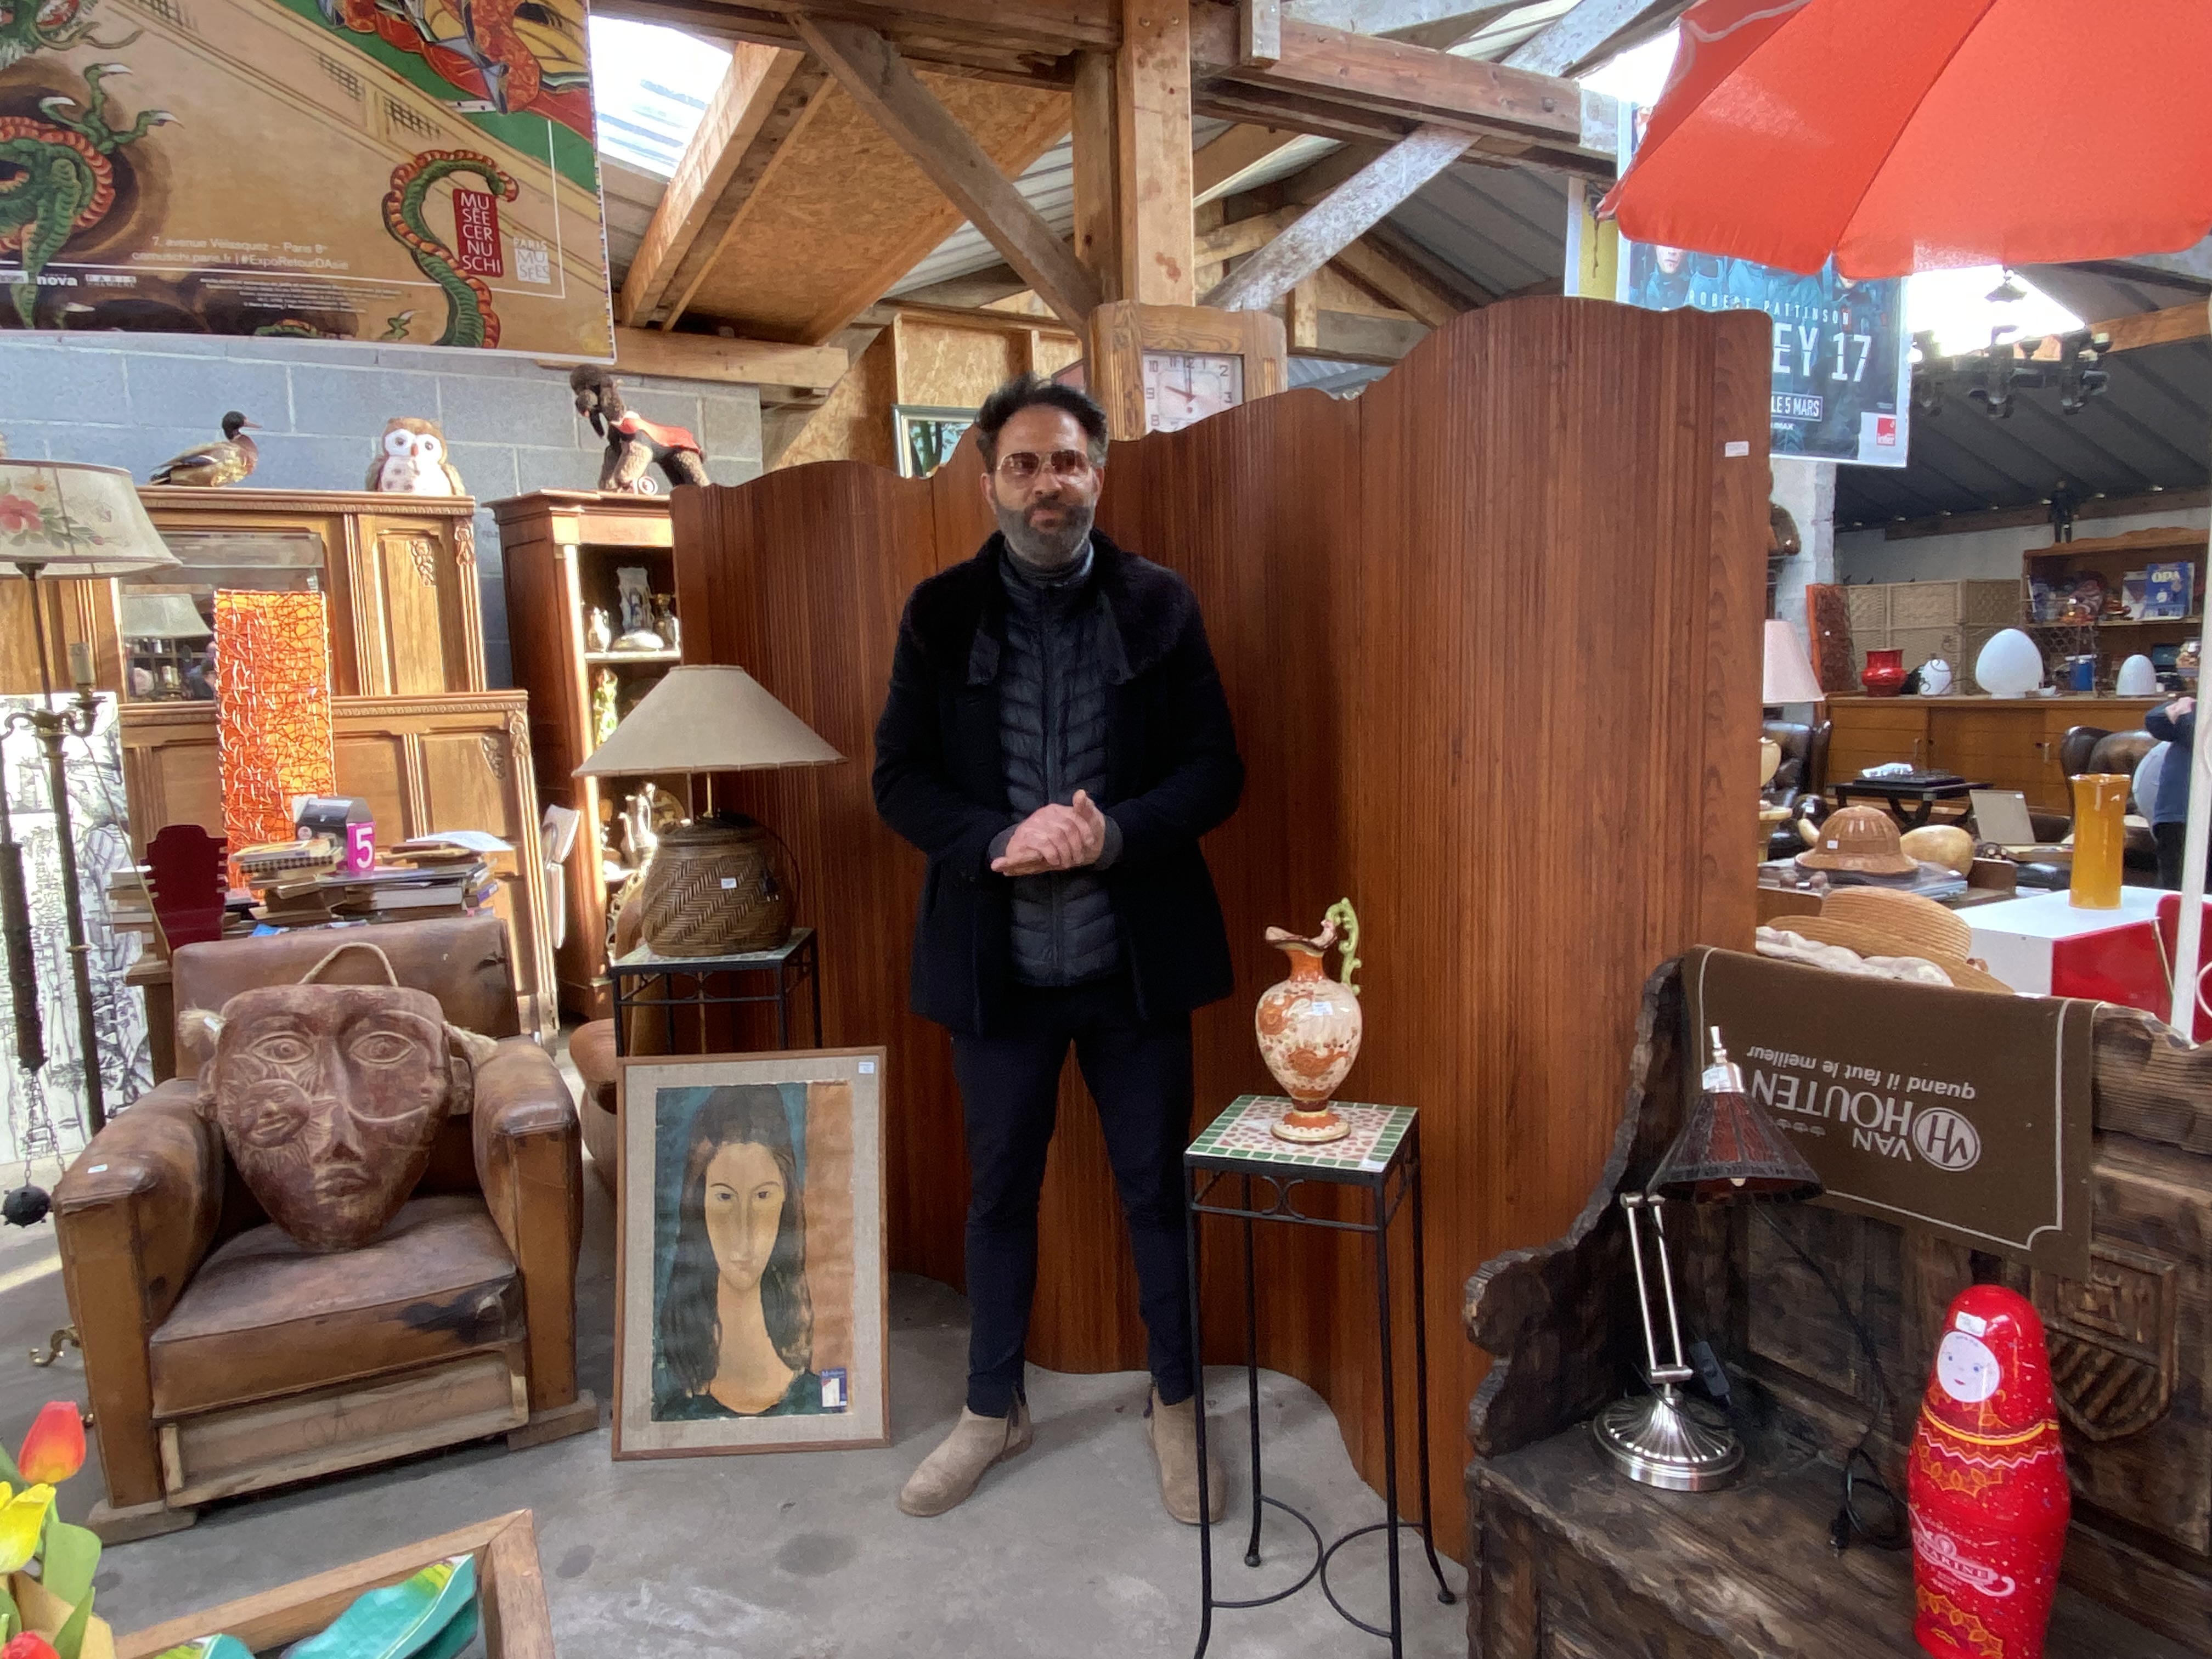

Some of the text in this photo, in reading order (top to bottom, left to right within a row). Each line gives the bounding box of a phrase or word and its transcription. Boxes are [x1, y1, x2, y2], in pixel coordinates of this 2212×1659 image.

[460, 192, 489, 210] MU
[462, 224, 493, 241] CER
[466, 239, 493, 257] NU
[513, 236, 548, 251] PARIS
[462, 255, 500, 273] SCHI
[517, 250, 545, 264] MU
[37, 275, 78, 286] nova
[1688, 289, 1848, 325] ROBERT PATTINSON
[1832, 332, 1871, 382] 17
[1149, 360, 1158, 373] 10
[1219, 365, 1228, 377] 2
[1146, 387, 1155, 399] 9
[1771, 396, 1819, 417] LE 5 MARS
[1151, 414, 1160, 426] 8
[356, 827, 373, 868] 5
[1746, 1046, 1975, 1099] quand il faut le meilleur
[1752, 1069, 1914, 1136] HOUTEN
[1852, 1127, 1912, 1162] VAN
